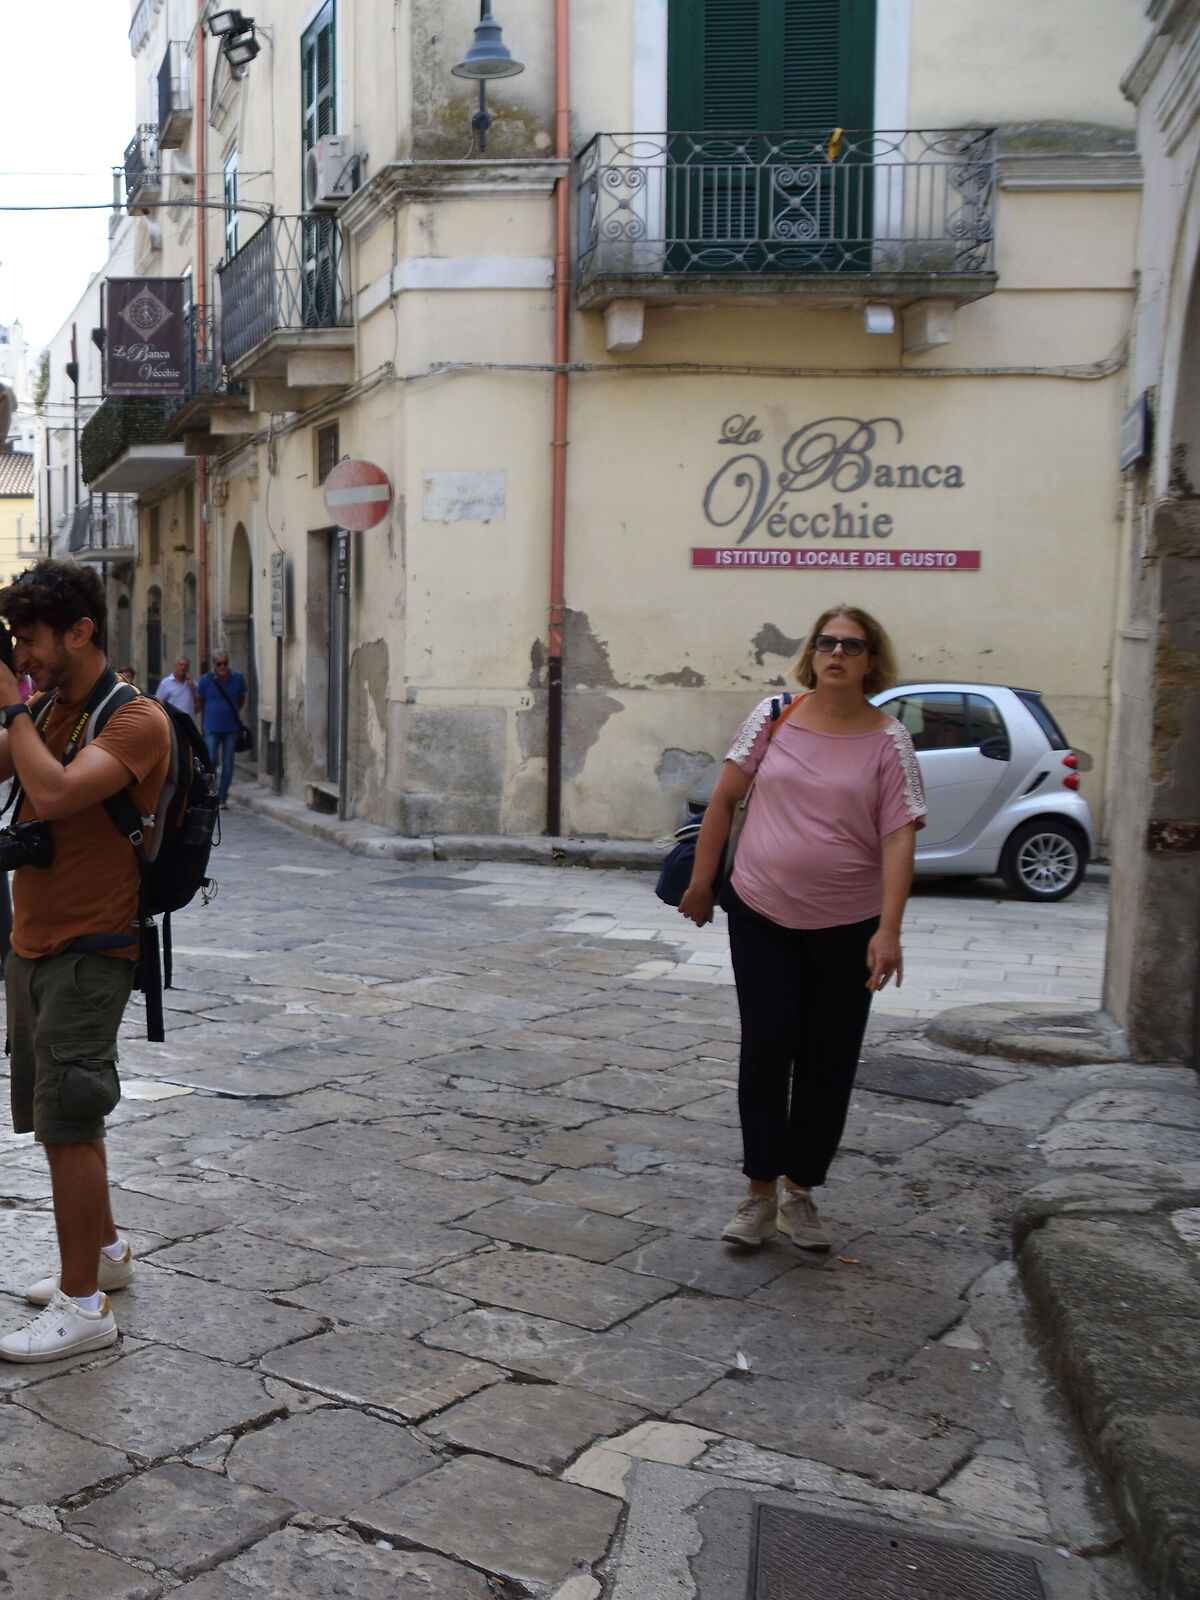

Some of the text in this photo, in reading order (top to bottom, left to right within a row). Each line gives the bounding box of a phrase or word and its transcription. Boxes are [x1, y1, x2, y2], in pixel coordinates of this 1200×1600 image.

[127, 343, 170, 361] Banca
[717, 413, 763, 445] La
[777, 416, 966, 493] Banca
[715, 551, 957, 567] ISTITUTO LOCALE DEL GUSTO
[71, 712, 89, 742] Nikon
